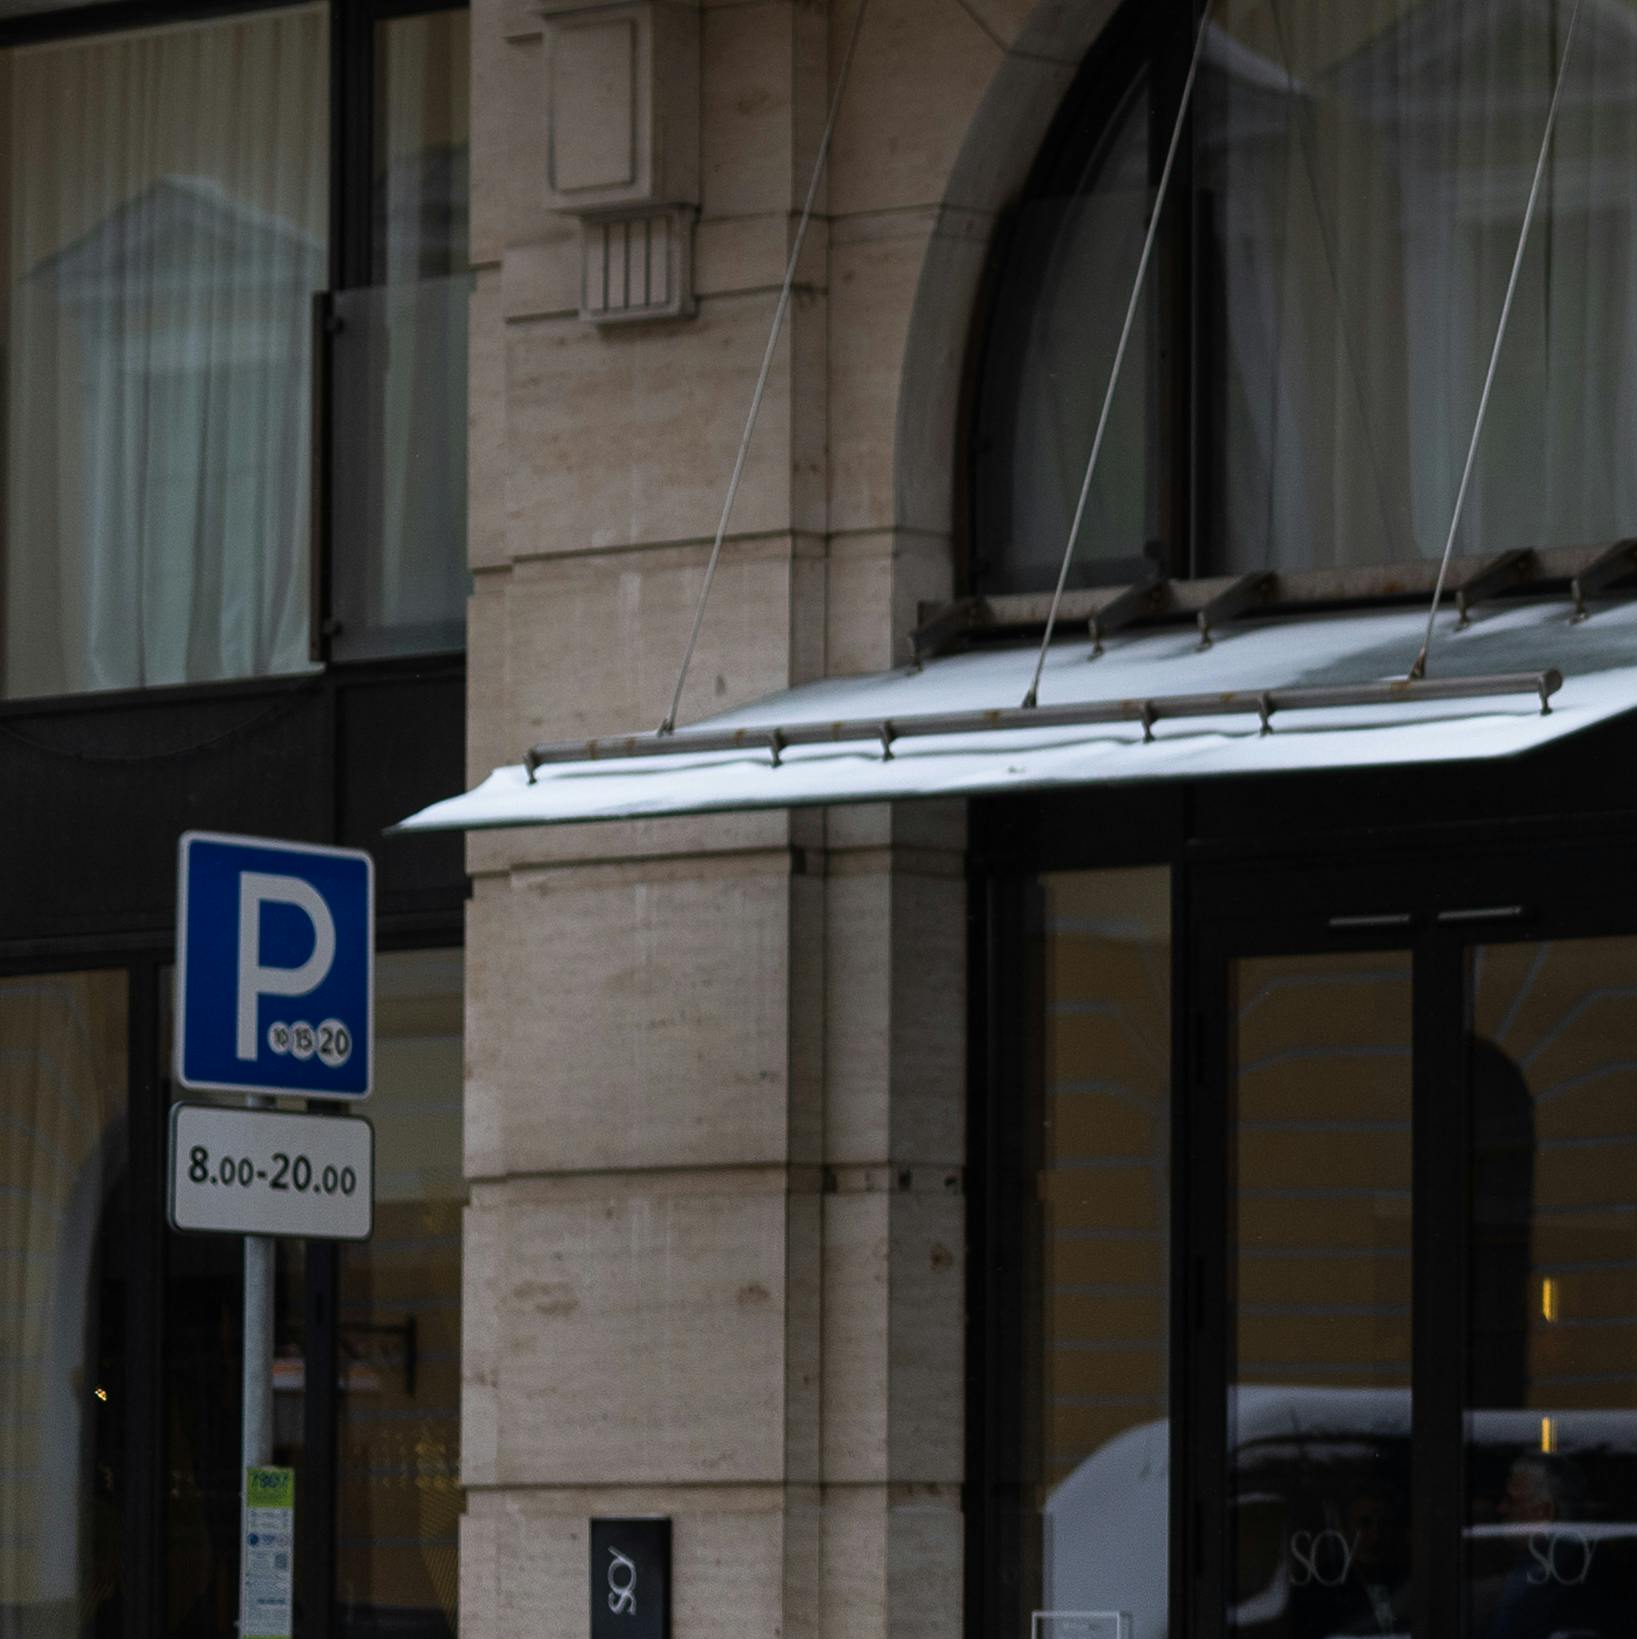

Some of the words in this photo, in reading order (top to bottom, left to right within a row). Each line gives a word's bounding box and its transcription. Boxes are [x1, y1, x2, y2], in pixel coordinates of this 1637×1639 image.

[236, 871, 336, 1062] P
[273, 1028, 288, 1047] 10
[294, 1028, 313, 1051] 15
[320, 1027, 349, 1057] 20
[188, 1145, 356, 1195] 8.00-20.00
